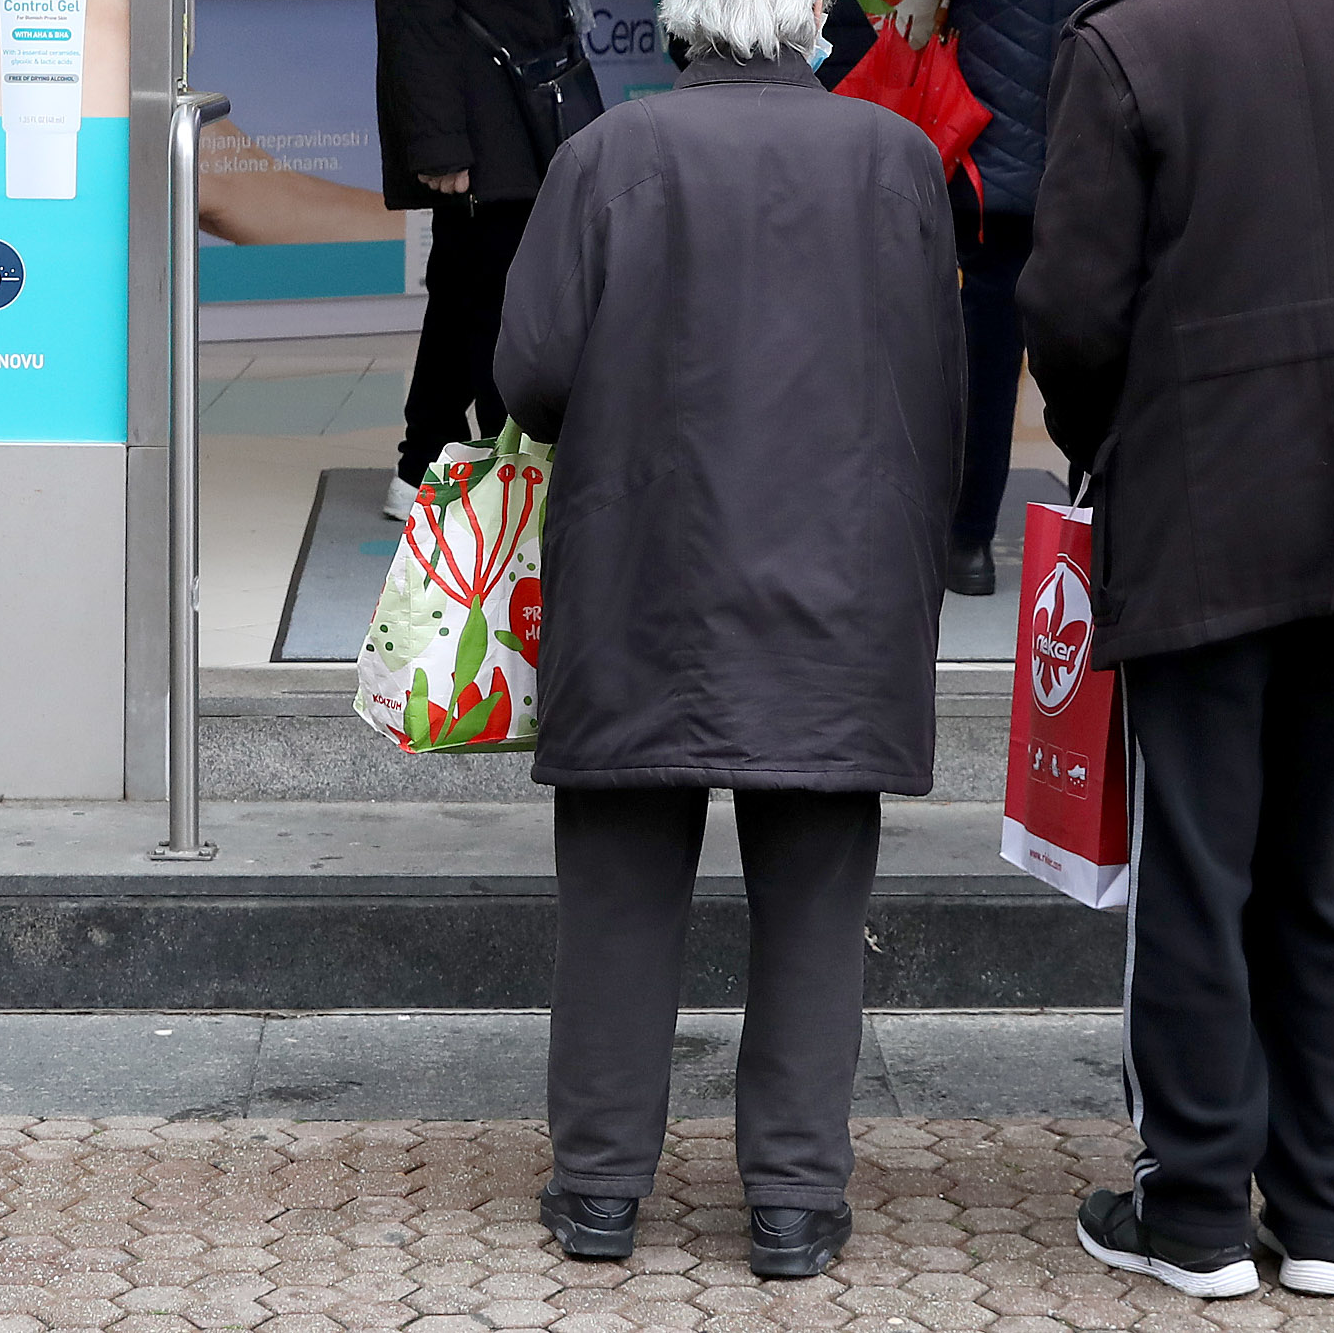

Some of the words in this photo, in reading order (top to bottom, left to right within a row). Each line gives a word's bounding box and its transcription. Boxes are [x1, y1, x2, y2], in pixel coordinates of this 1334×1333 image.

[4, 0, 53, 12] Control
[57, 0, 80, 12] Gel
[257, 130, 360, 151] nepravilnosti
[214, 156, 269, 174] sklone
